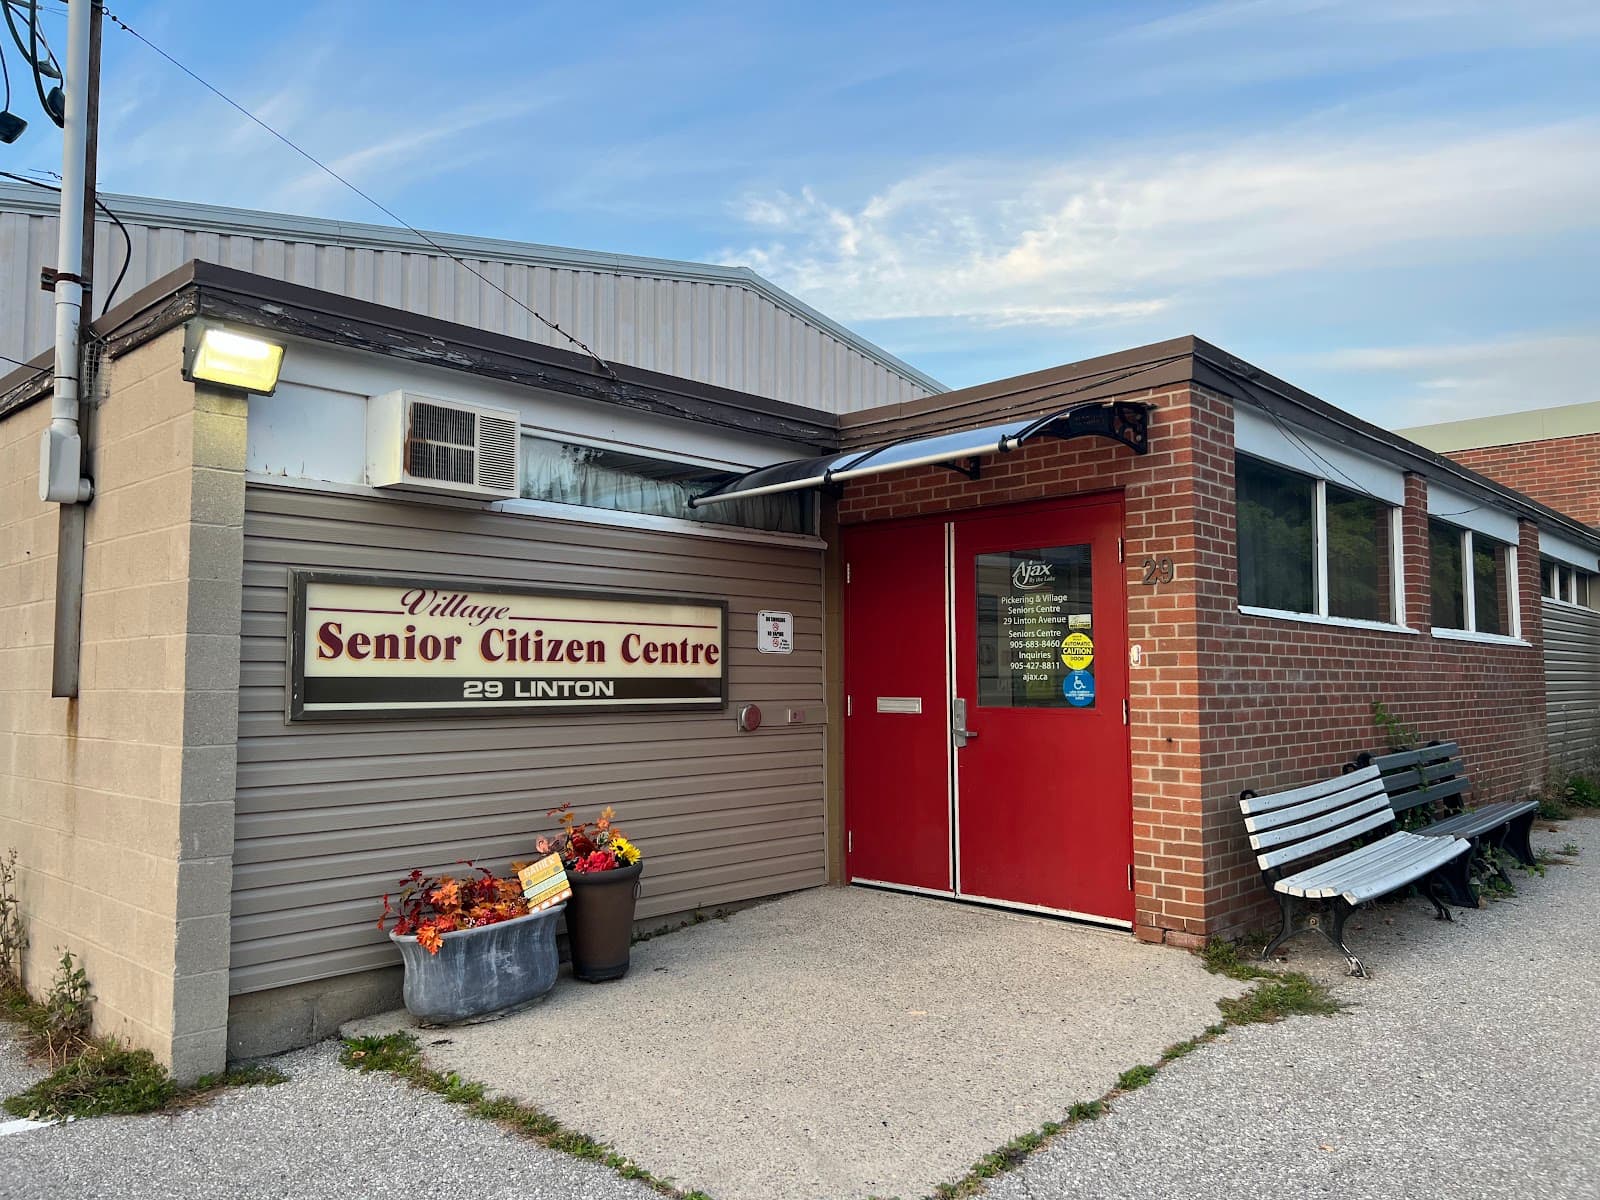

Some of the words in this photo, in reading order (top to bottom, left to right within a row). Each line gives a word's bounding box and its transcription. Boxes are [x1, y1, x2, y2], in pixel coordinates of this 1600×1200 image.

[1012, 560, 1053, 585] Ajax
[1142, 557, 1174, 585] 29
[1001, 595, 1034, 604] Pickering
[1035, 594, 1041, 602] &
[1042, 593, 1068, 603] Village
[401, 588, 510, 627] Village
[1008, 606, 1035, 614] Seniors
[1035, 605, 1061, 613] Centre
[1003, 617, 1012, 625] 29
[1013, 616, 1037, 625] Linton
[1038, 615, 1067, 624] Avenue
[1009, 630, 1035, 638] Seniors
[1036, 629, 1061, 637] Centre
[317, 622, 462, 662] Senior
[479, 628, 606, 663] Citizen
[620, 633, 719, 665] Centre
[1010, 640, 1060, 649] 905-683-8460
[1018, 651, 1051, 660] Inquiries
[1062, 647, 1092, 655] CAUTION
[1010, 661, 1060, 670] 905-427-8811
[1022, 672, 1048, 682] ajax.ca
[463, 680, 503, 698] 29
[514, 680, 614, 697] LINTON
